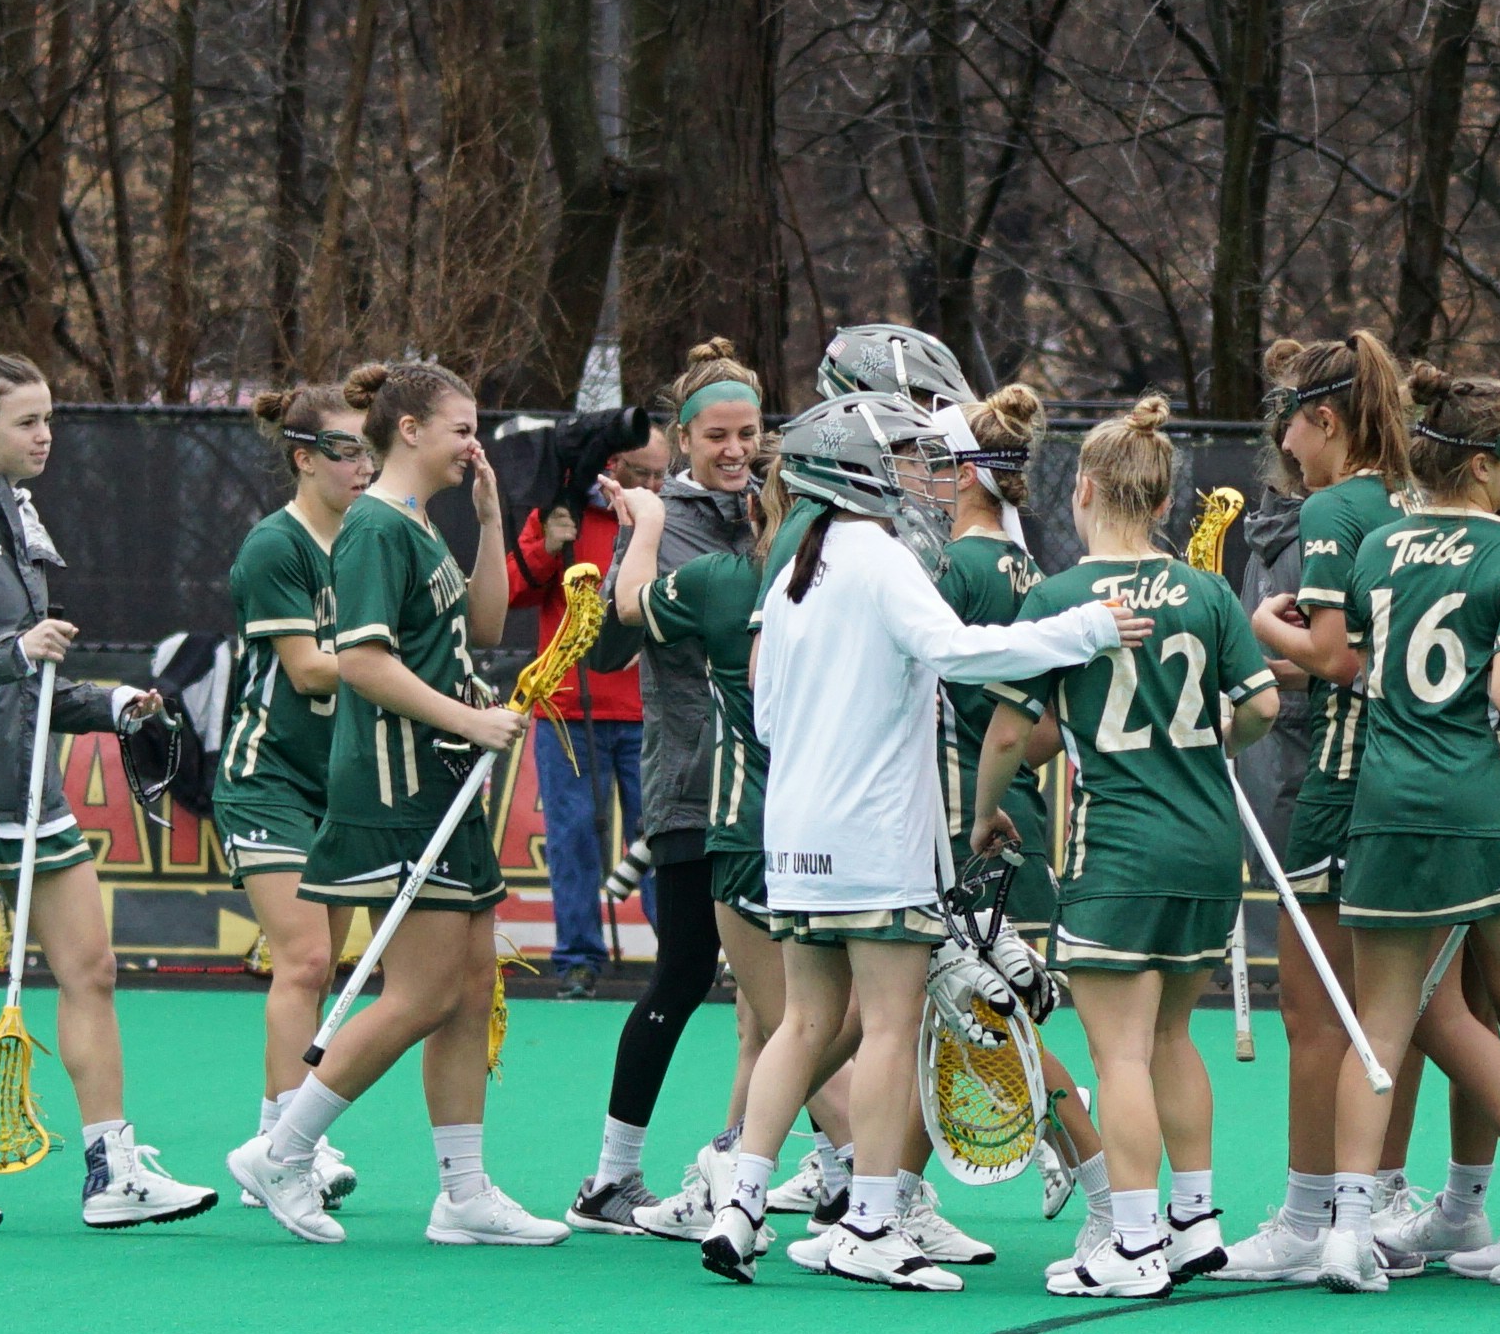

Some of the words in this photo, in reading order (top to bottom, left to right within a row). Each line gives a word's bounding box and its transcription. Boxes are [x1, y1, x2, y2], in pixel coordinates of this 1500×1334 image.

[1386, 527, 1476, 577] Tribe
[1091, 569, 1190, 610] Tribe
[1367, 588, 1467, 704] 16
[1084, 632, 1218, 753] 22
[401, 869, 423, 902] Tribe
[777, 850, 790, 874] UT
[793, 851, 833, 875] UNUM
[1238, 971, 1248, 1017] ELEVATE
